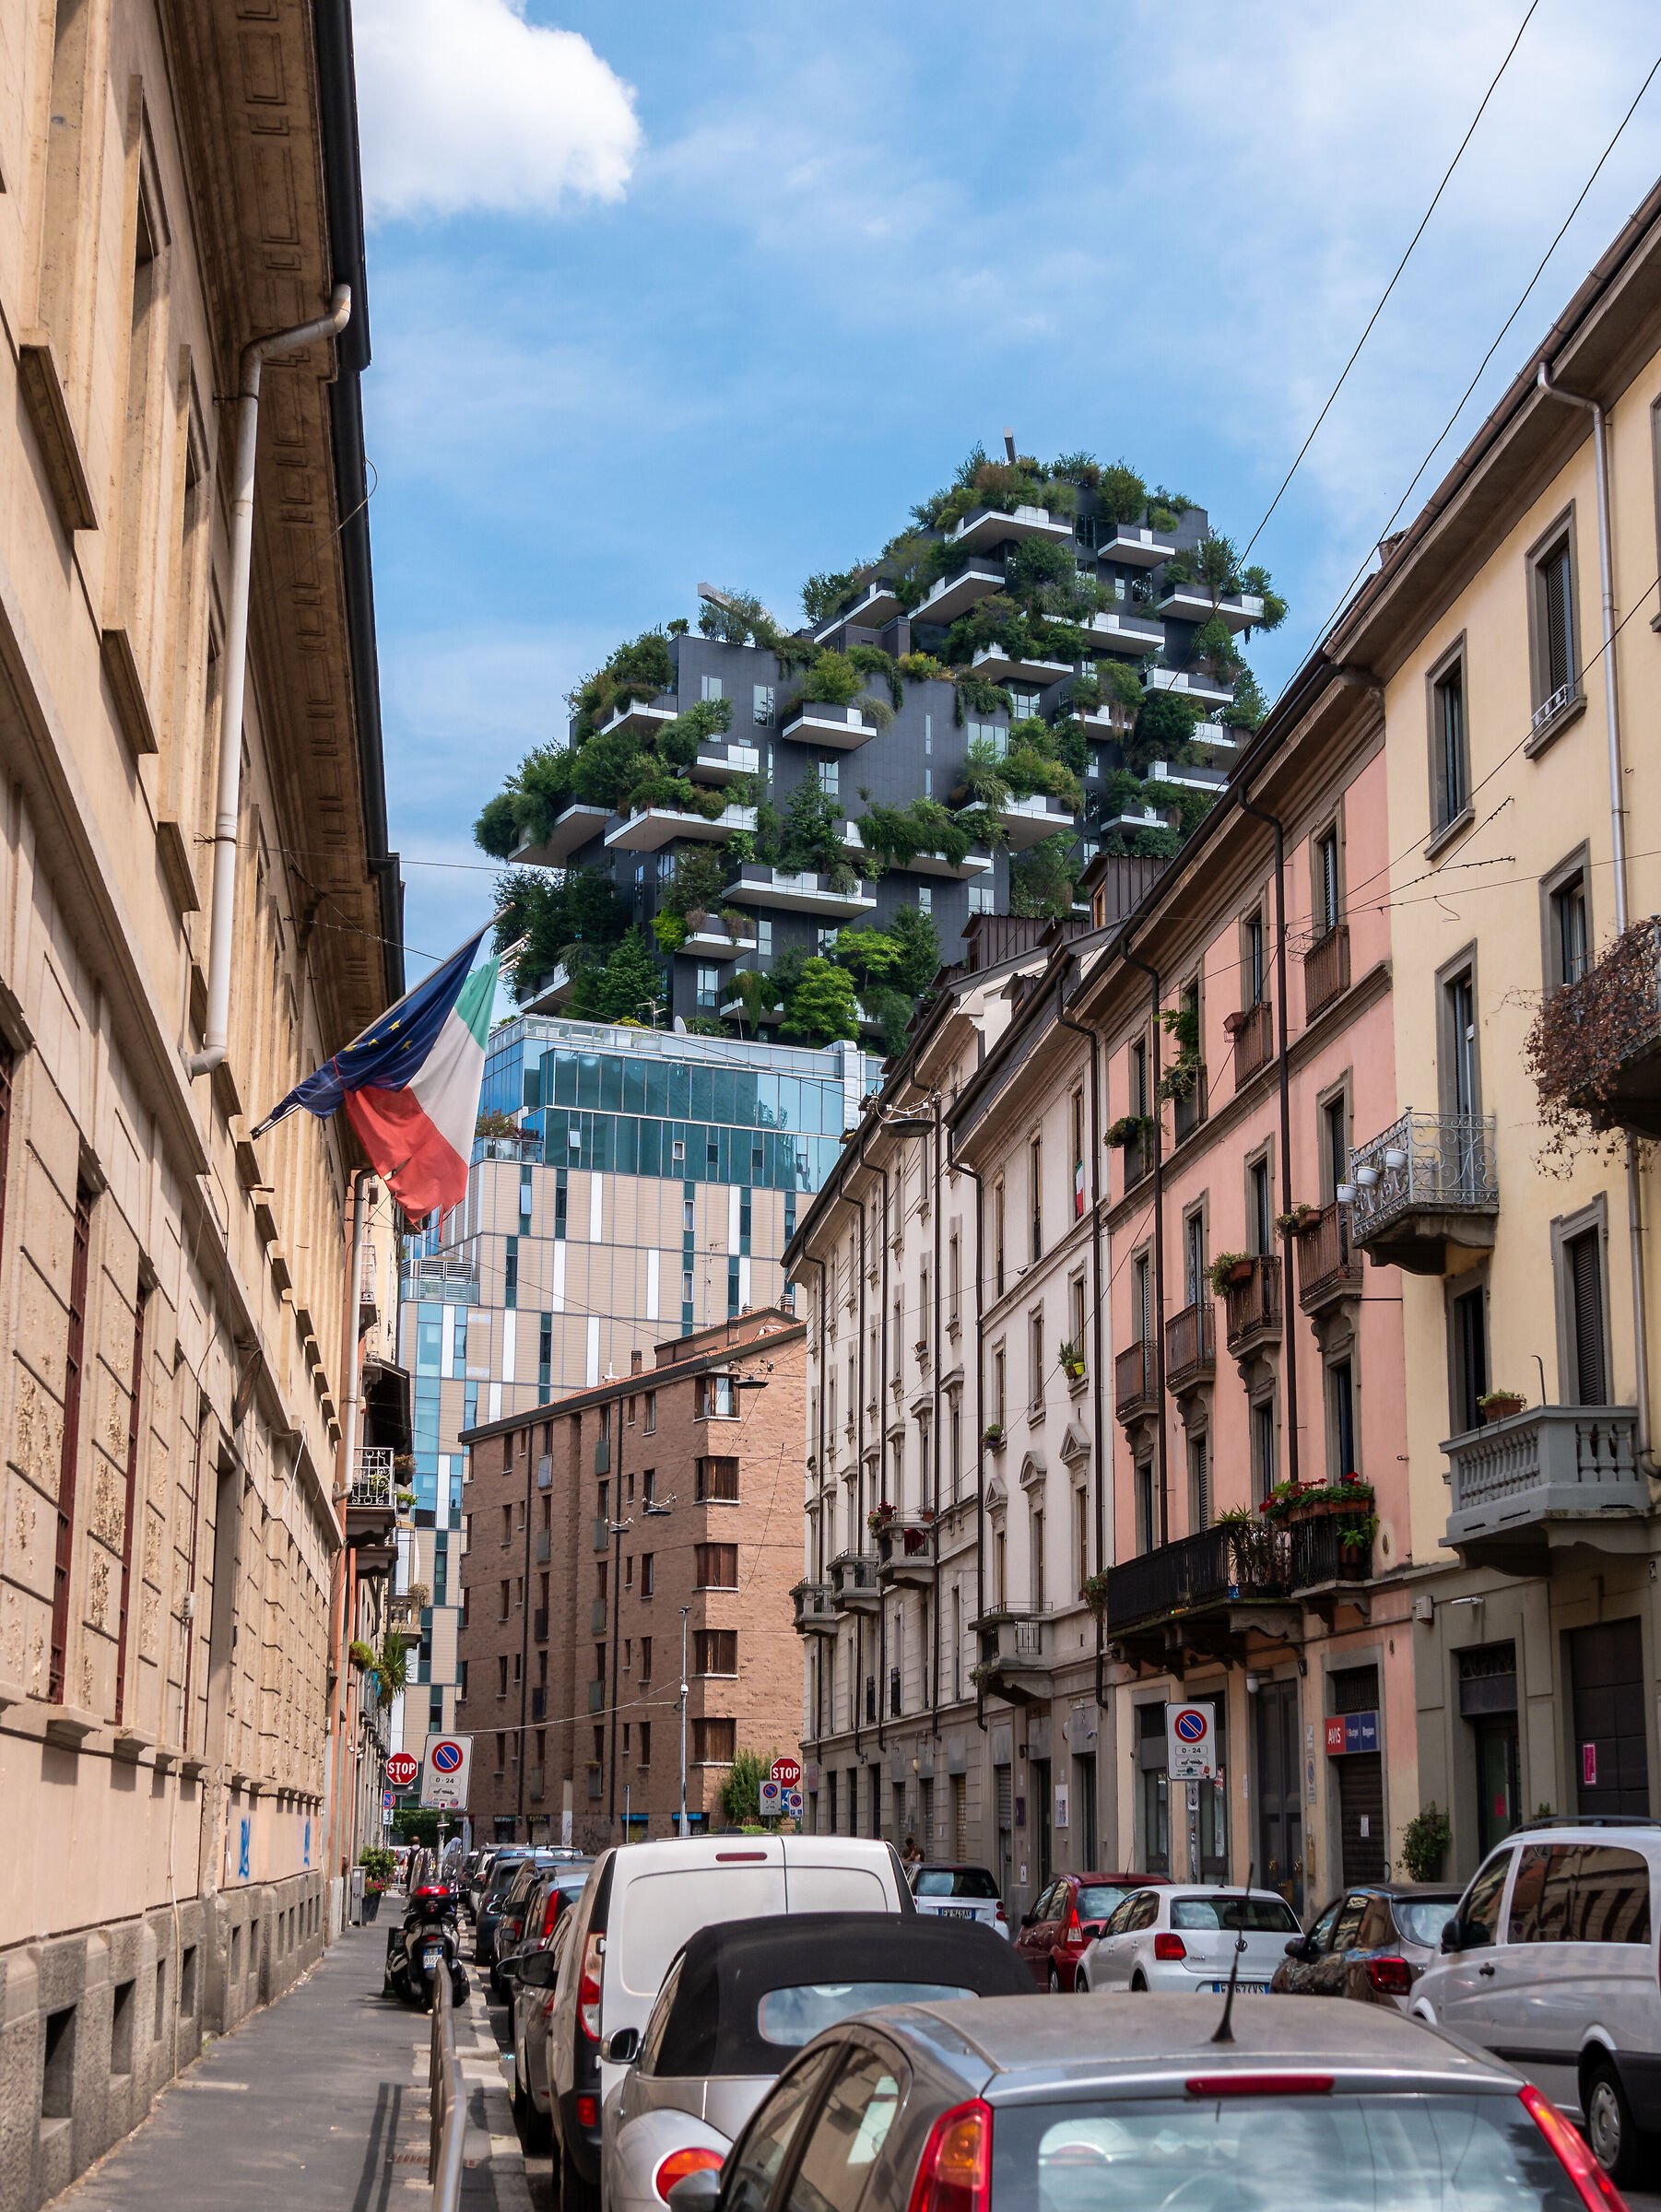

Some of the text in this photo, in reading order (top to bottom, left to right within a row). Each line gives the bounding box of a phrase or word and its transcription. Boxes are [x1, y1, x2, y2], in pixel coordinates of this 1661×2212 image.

[1327, 1726, 1341, 1745] AVIS
[388, 1761, 416, 1775] STOP
[772, 1767, 799, 1780] STOP
